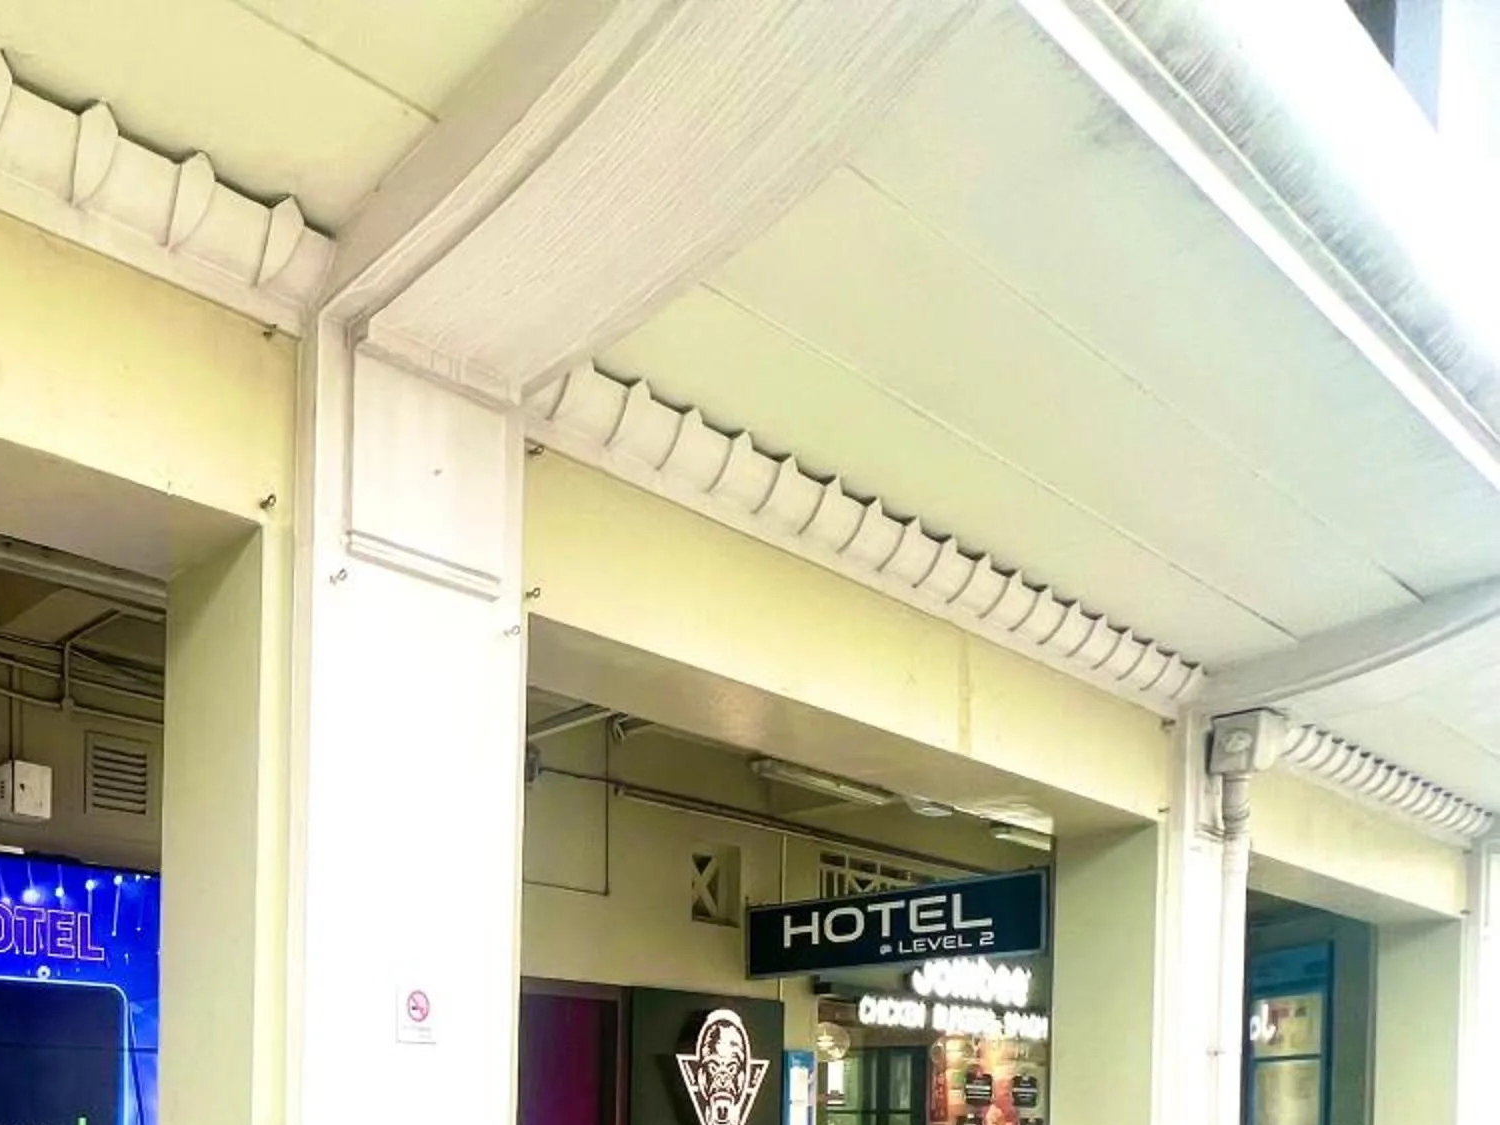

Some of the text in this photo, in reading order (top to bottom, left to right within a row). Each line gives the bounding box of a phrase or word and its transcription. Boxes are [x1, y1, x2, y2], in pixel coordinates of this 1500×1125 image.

[783, 893, 993, 948] HOTEL
[899, 934, 972, 954] LEVEL
[979, 931, 995, 946] 2
